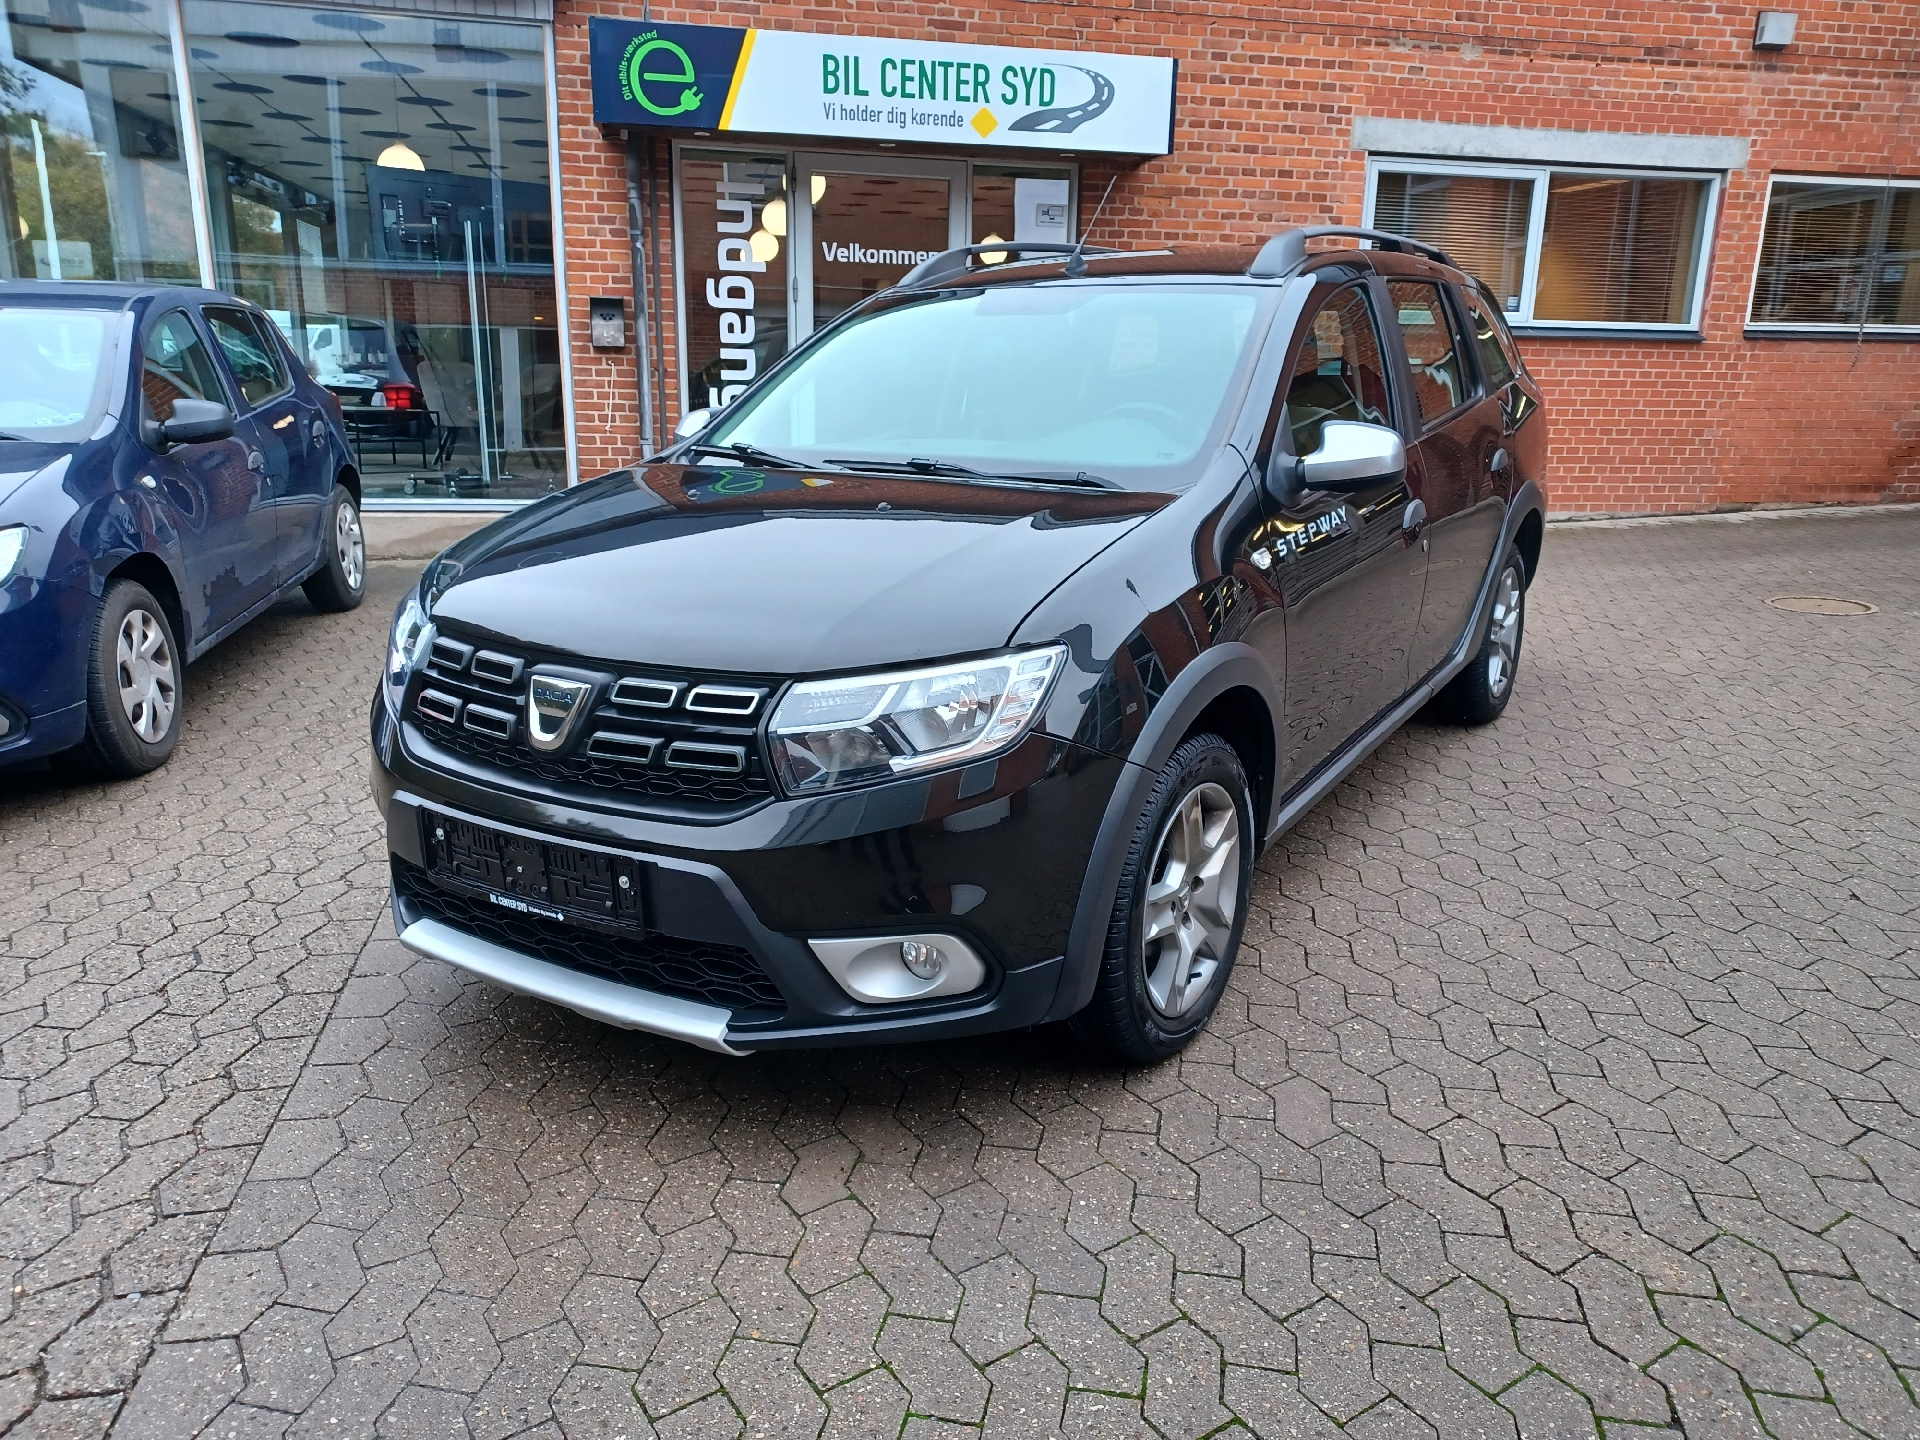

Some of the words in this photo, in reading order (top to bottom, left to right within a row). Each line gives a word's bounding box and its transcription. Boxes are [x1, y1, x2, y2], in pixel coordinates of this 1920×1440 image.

[619, 30, 657, 84] elbils-værksted
[622, 86, 632, 100] Dit
[822, 53, 869, 96] BIL
[880, 57, 991, 103] CENTER
[1001, 65, 1056, 107] SYD
[823, 102, 836, 121] Vi
[840, 104, 883, 123] holder
[887, 107, 907, 129] dig
[911, 108, 964, 128] kørende
[1276, 505, 1348, 557] STEPWAY
[533, 687, 573, 703] DACIA
